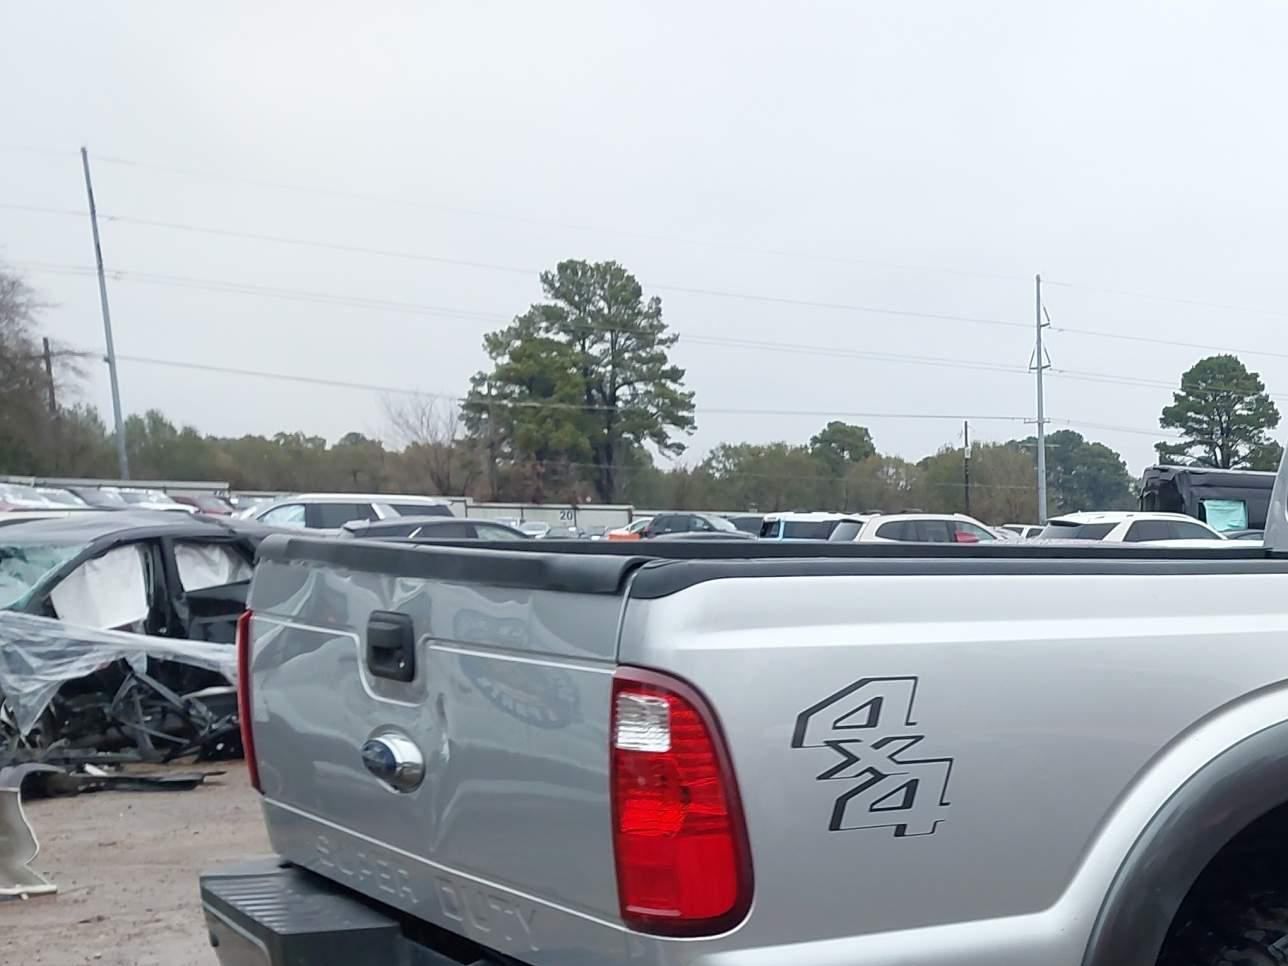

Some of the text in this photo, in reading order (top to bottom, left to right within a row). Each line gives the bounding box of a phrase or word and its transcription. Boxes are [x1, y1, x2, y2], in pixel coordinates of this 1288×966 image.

[560, 510, 573, 521] 20
[316, 834, 541, 952] SUPER DUTY
